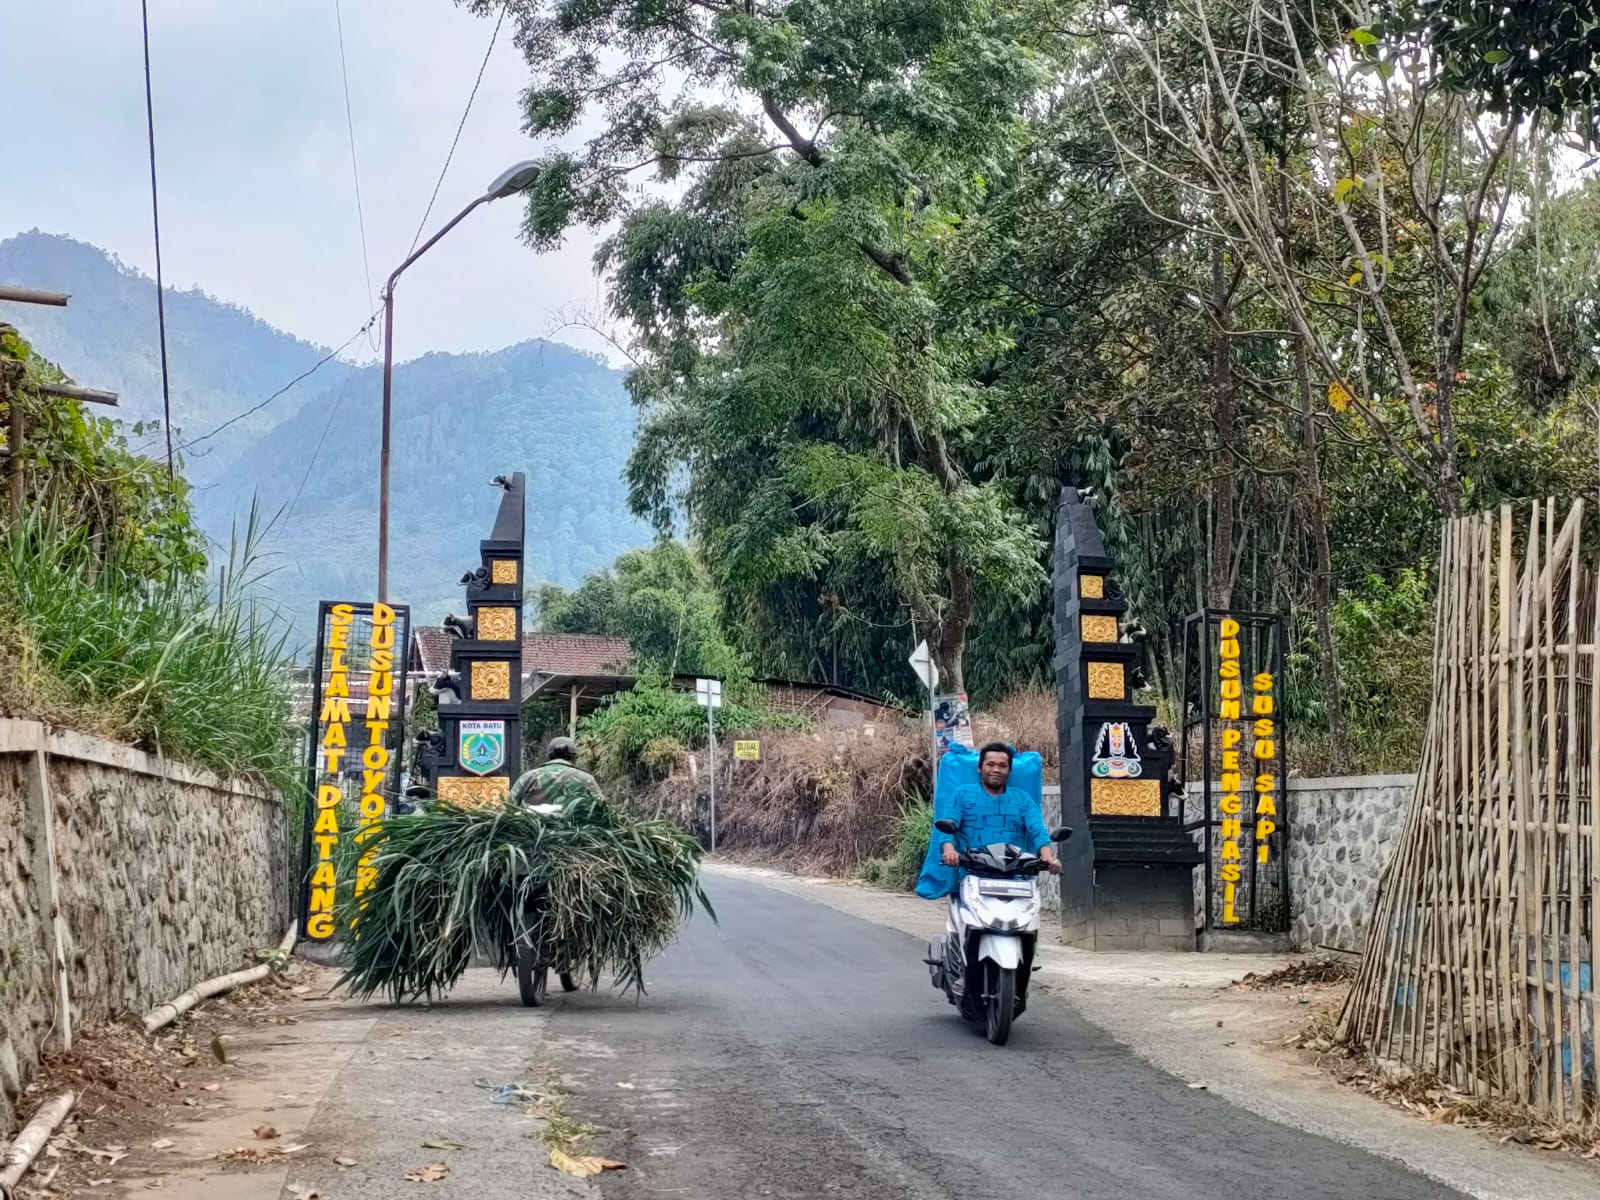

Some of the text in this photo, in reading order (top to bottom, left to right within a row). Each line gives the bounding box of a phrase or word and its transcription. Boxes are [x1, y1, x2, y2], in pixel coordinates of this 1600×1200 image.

[306, 603, 354, 939] SELAMAT DATANG
[367, 602, 395, 720] DUSUN
[1219, 618, 1242, 923] DUSUN PENGHASIL
[1253, 672, 1276, 864] SUSU SAPI
